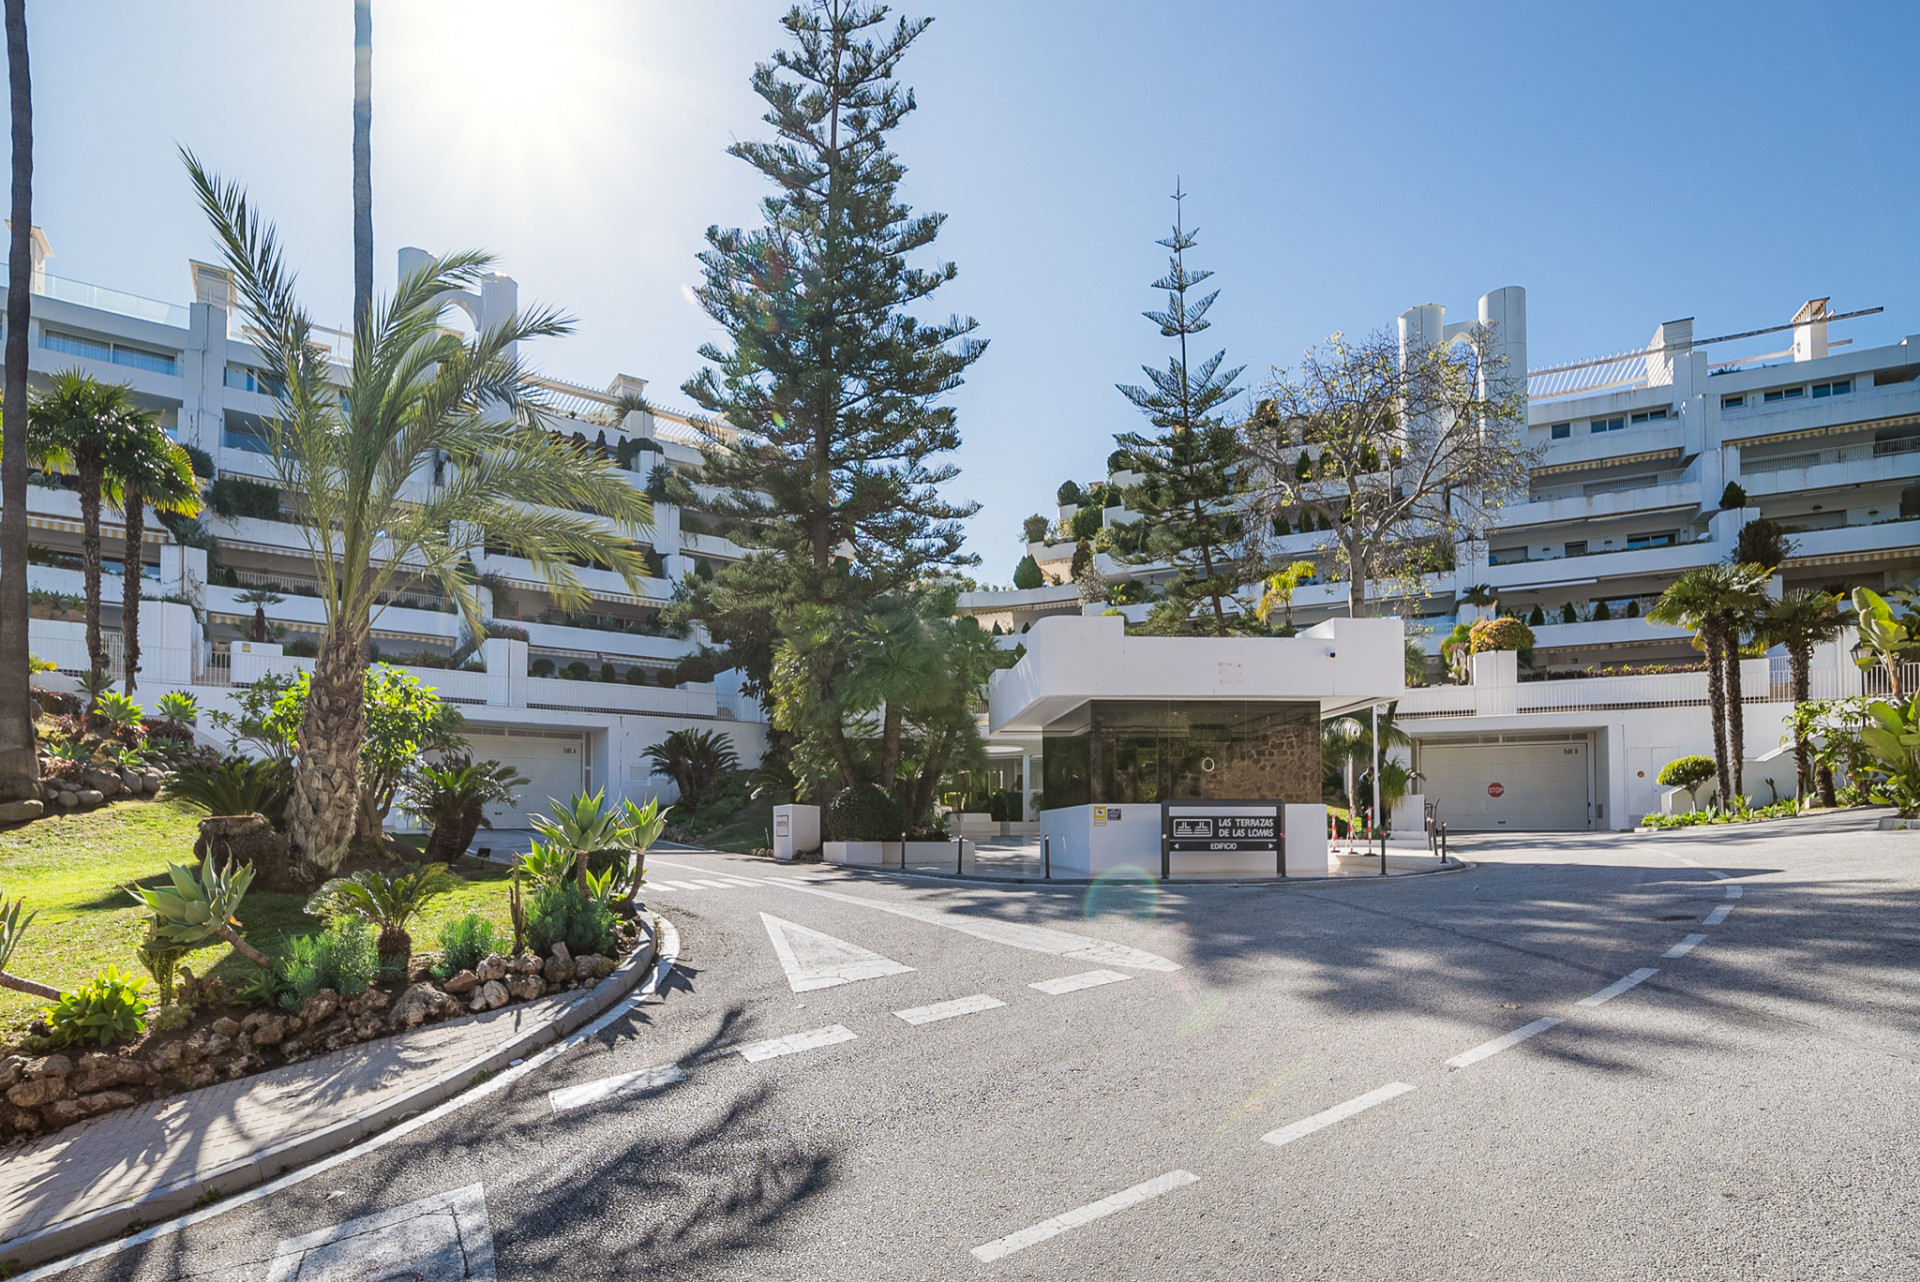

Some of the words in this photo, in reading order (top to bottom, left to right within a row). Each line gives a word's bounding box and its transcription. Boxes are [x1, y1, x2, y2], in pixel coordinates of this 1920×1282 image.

[1219, 819, 1232, 827] LAS
[1235, 819, 1274, 827] TERRAZAS
[1219, 829, 1230, 837] DE
[1233, 829, 1246, 837] LAS
[1248, 829, 1274, 837] LOMAS
